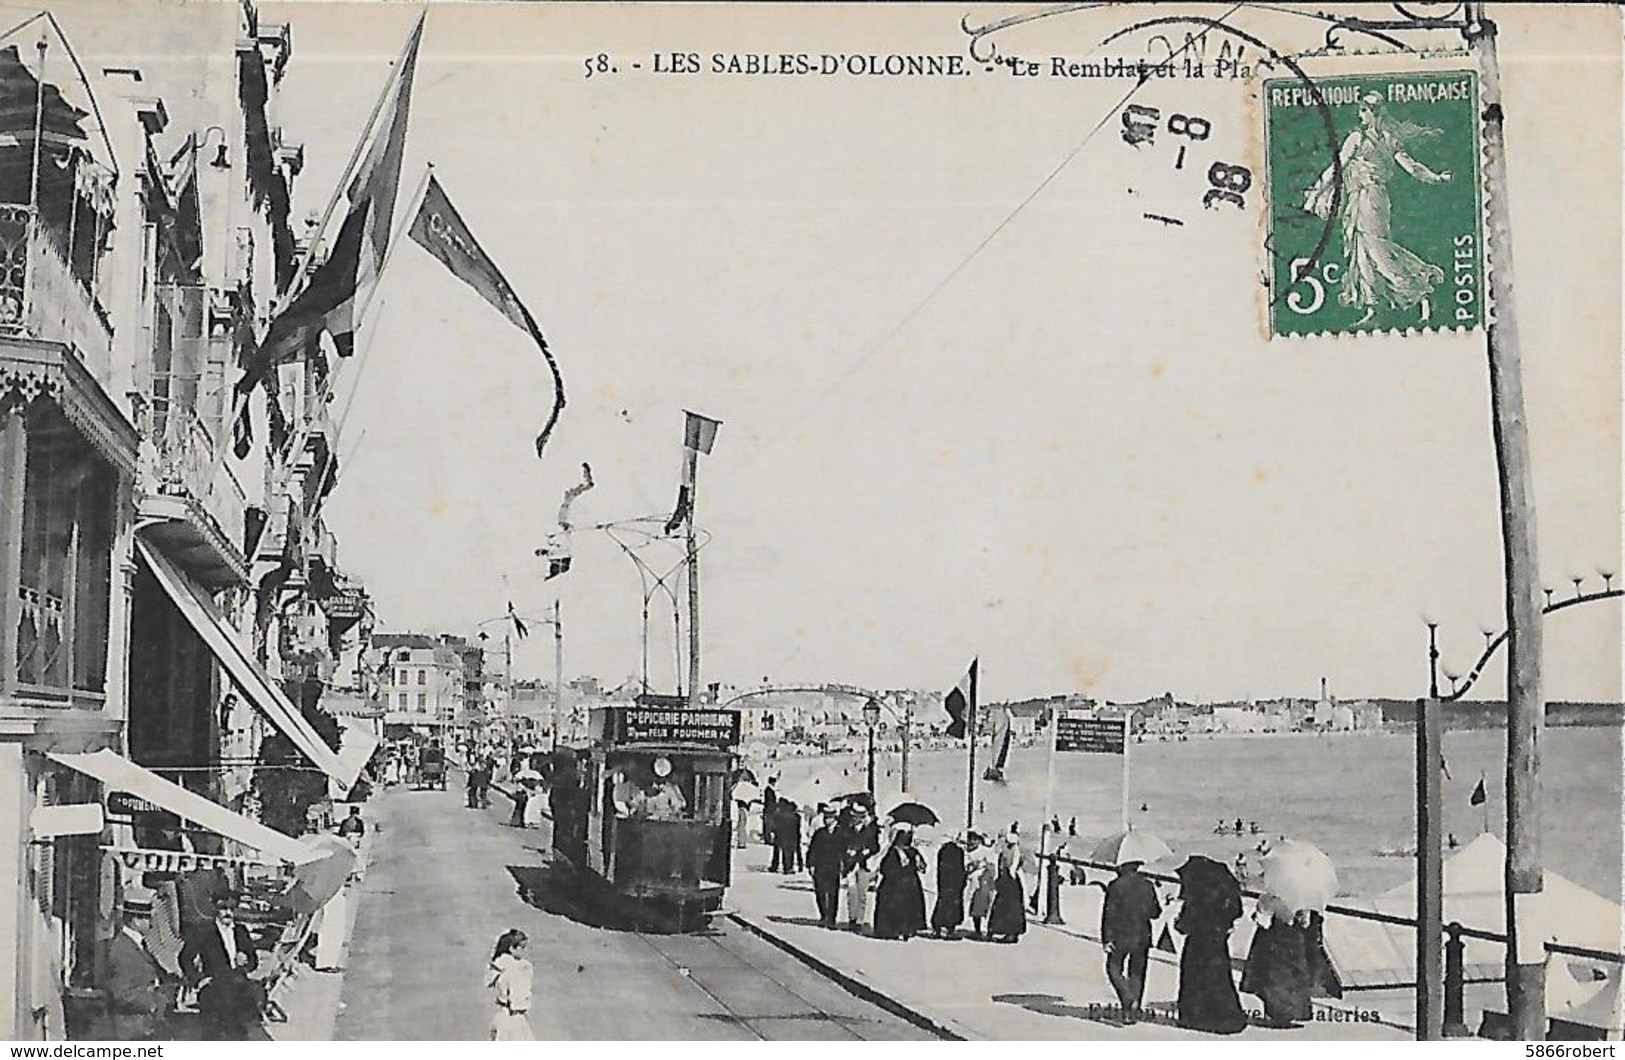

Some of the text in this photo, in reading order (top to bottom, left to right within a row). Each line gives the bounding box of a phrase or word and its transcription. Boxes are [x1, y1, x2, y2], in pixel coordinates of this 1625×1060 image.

[1387, 82, 1470, 103] FRANÇAISE
[1453, 234, 1474, 320] POSTES
[639, 710, 680, 725] EPICERIE
[673, 728, 718, 739] FOUCHER
